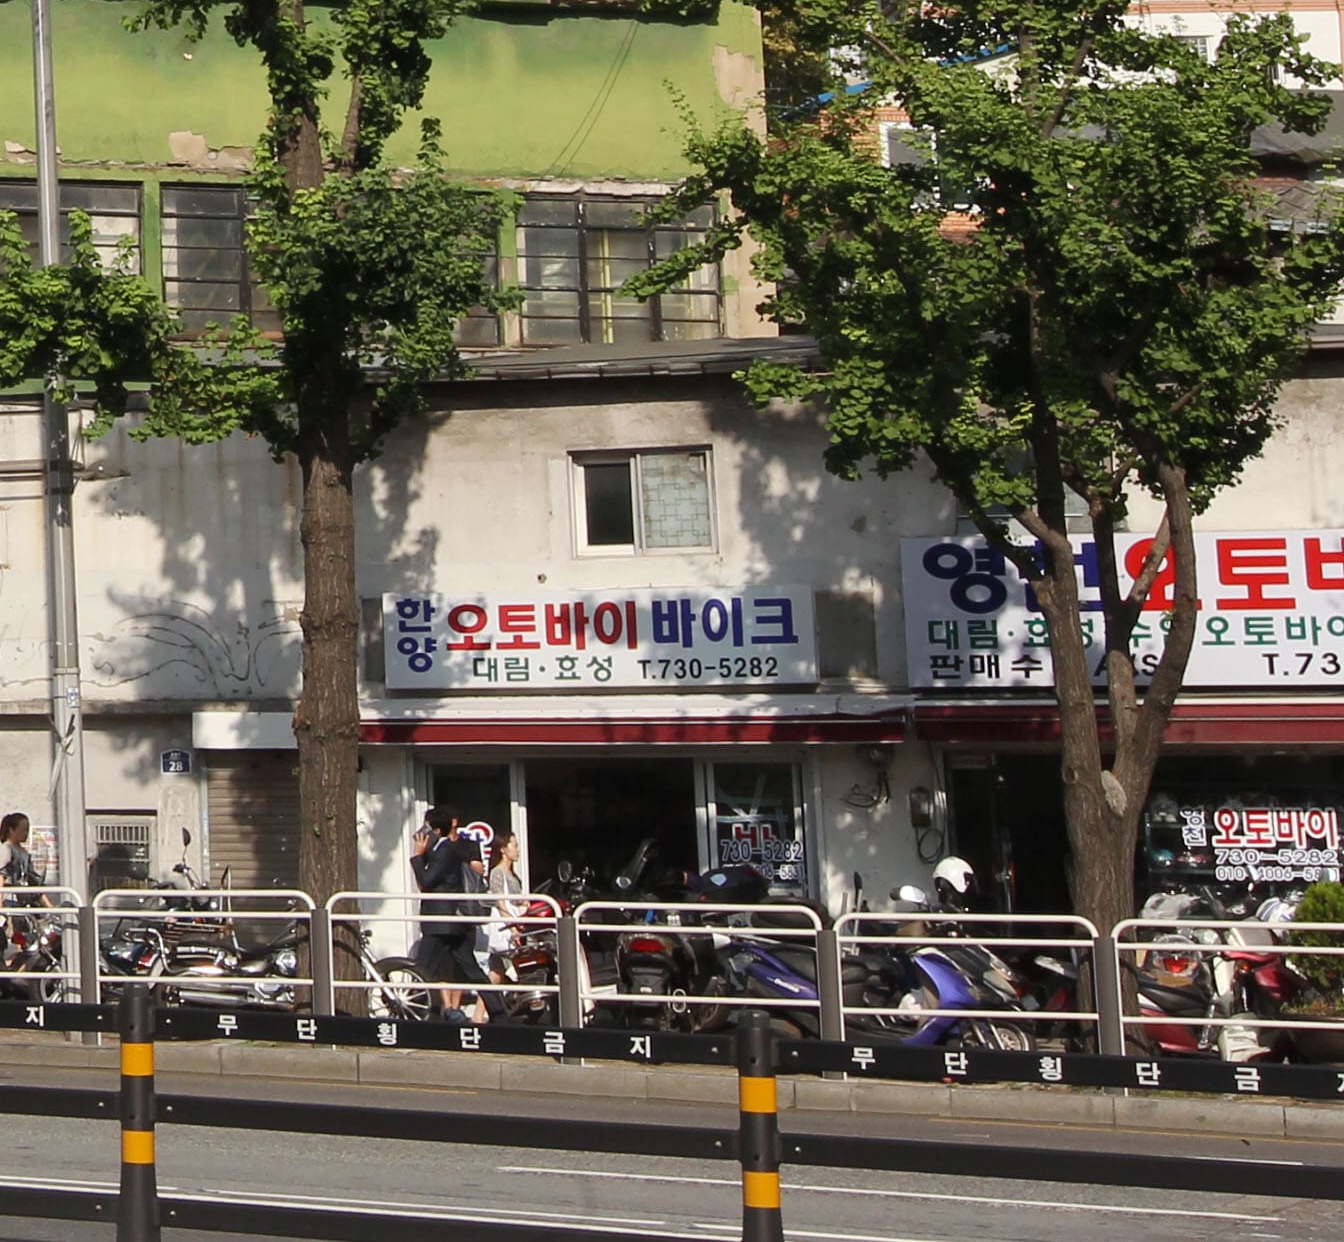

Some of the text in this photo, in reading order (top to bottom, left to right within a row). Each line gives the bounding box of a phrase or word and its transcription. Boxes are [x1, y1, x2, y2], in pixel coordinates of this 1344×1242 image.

[396, 597, 799, 673] 한양 오토바이 바이크
[929, 652, 1045, 680] 판매수
[169, 761, 183, 772] 28
[1212, 808, 1339, 850] 오토바이
[720, 839, 803, 862] 730-5282
[1214, 848, 1338, 866] 730-5282
